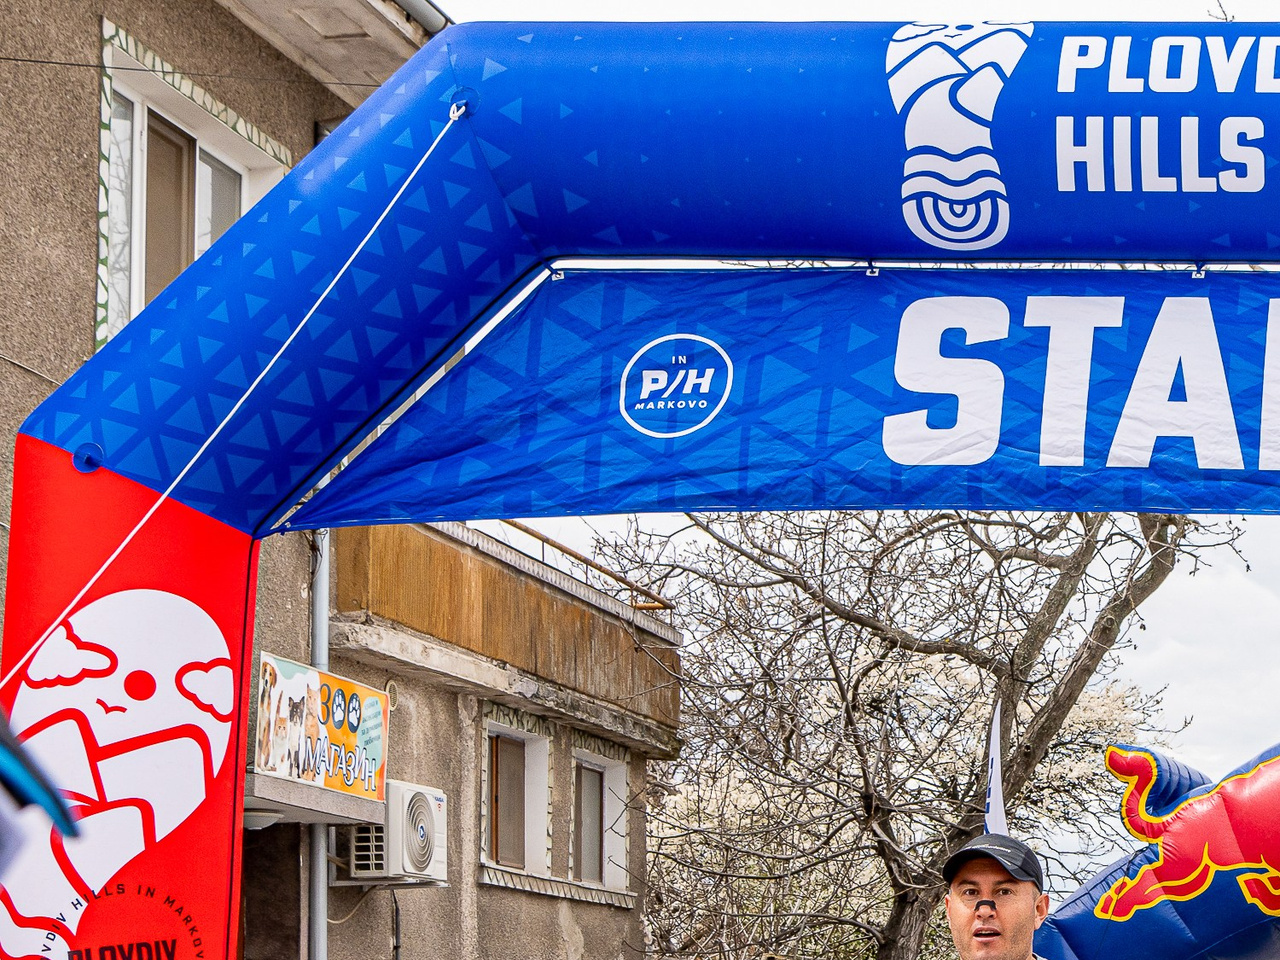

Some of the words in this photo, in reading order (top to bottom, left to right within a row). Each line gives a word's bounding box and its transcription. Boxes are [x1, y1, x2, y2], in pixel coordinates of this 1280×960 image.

[1055, 115, 1266, 193] HILLS
[672, 355, 687, 364] IN
[640, 368, 715, 399] P/H
[634, 400, 708, 410] MARKOVO
[305, 736, 376, 791] МАГАЗИН
[71, 883, 125, 910] HILLS
[137, 885, 156, 898] IN
